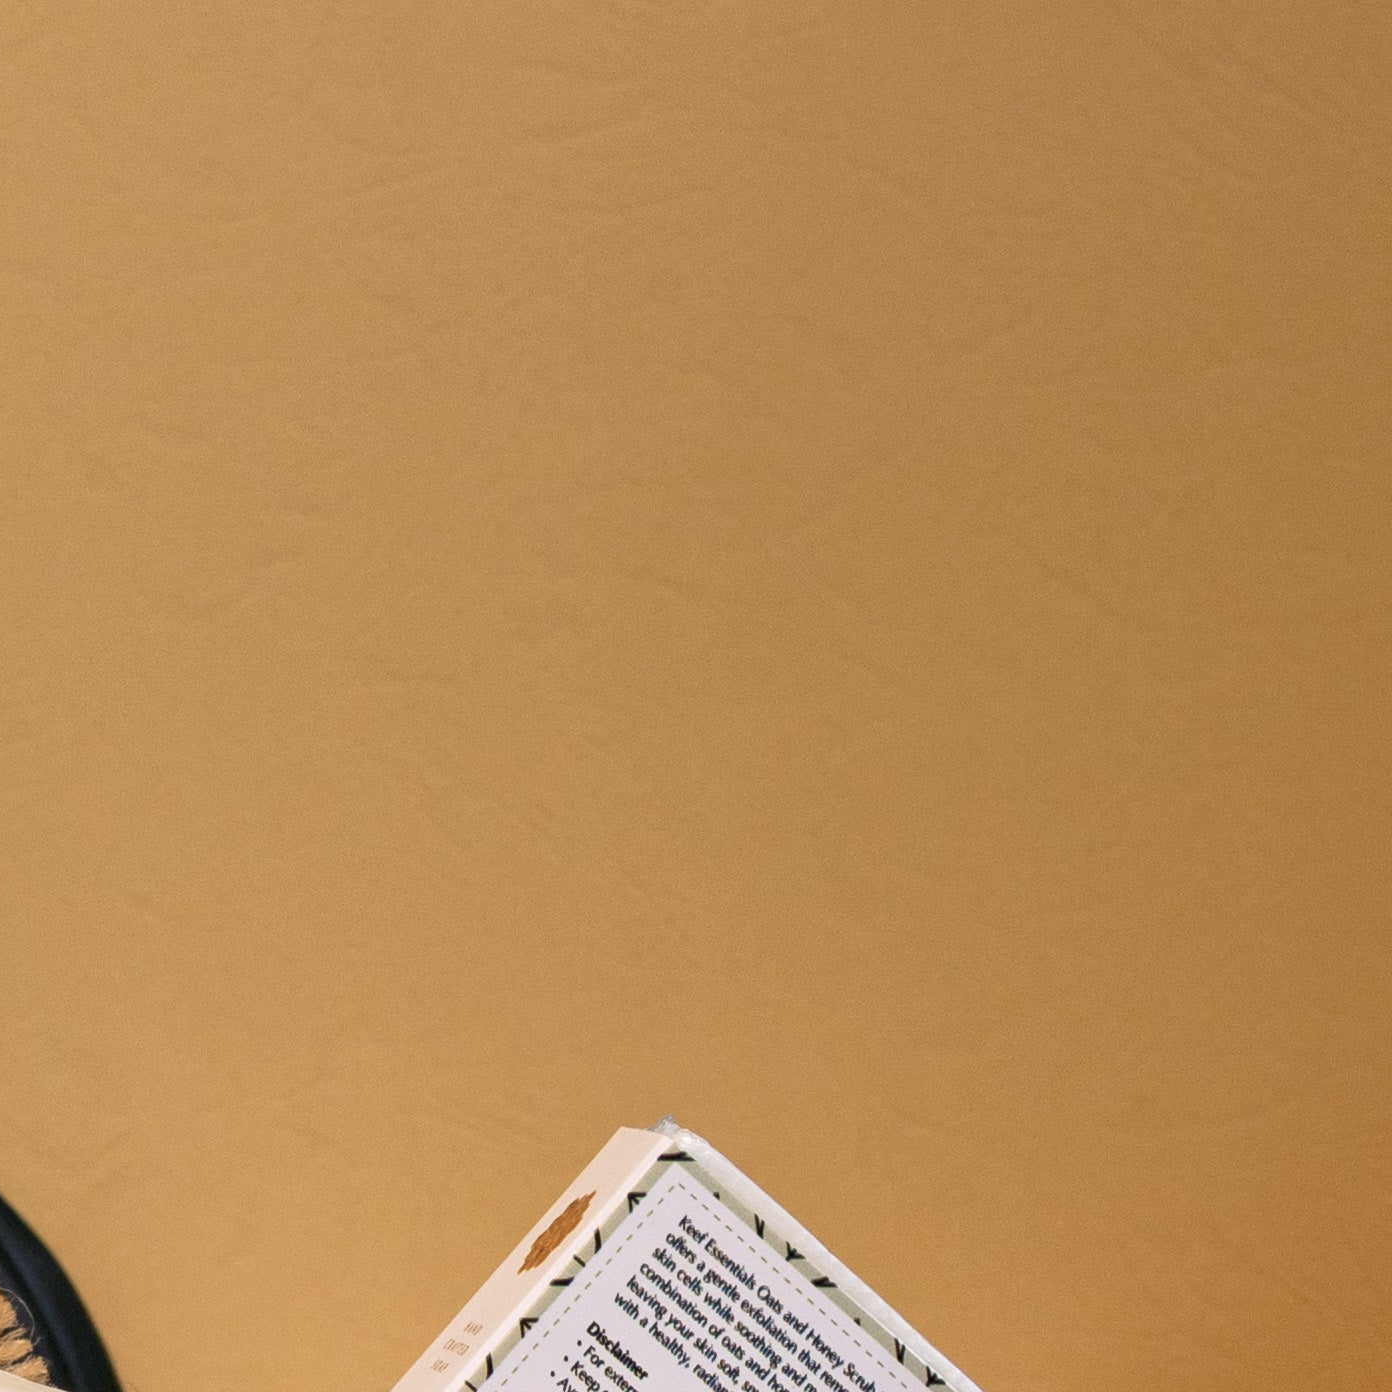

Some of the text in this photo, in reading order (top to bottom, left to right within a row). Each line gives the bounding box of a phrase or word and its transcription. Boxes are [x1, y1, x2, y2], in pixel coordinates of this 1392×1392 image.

[614, 1292, 640, 1320] with
[639, 1317, 649, 1329] a
[648, 1321, 691, 1369] healthy,
[626, 1274, 668, 1321] leaving
[664, 1313, 695, 1340] your
[693, 1337, 718, 1363] skin
[716, 1359, 740, 1385] soft,
[639, 1263, 708, 1328] combination
[708, 1324, 726, 1340] of
[721, 1335, 746, 1361] oats
[744, 1357, 772, 1381] and
[652, 1247, 677, 1273] skin
[676, 1269, 703, 1296] cells
[703, 1292, 735, 1325] while
[734, 1321, 783, 1370] soothing
[781, 1363, 808, 1387] and
[665, 1233, 697, 1264] offers
[696, 1261, 706, 1273] a
[702, 1269, 741, 1303] gentle
[740, 1299, 798, 1355] exfoliation
[797, 1349, 822, 1375] that
[678, 1215, 709, 1244] Keef
[704, 1238, 756, 1291] Essentials
[757, 1285, 784, 1315] Oats
[782, 1311, 809, 1335] and
[805, 1328, 844, 1370] Honey
[570, 1360, 601, 1392] Keep
[583, 1345, 605, 1368] For
[586, 1321, 649, 1380] Disclaimer
